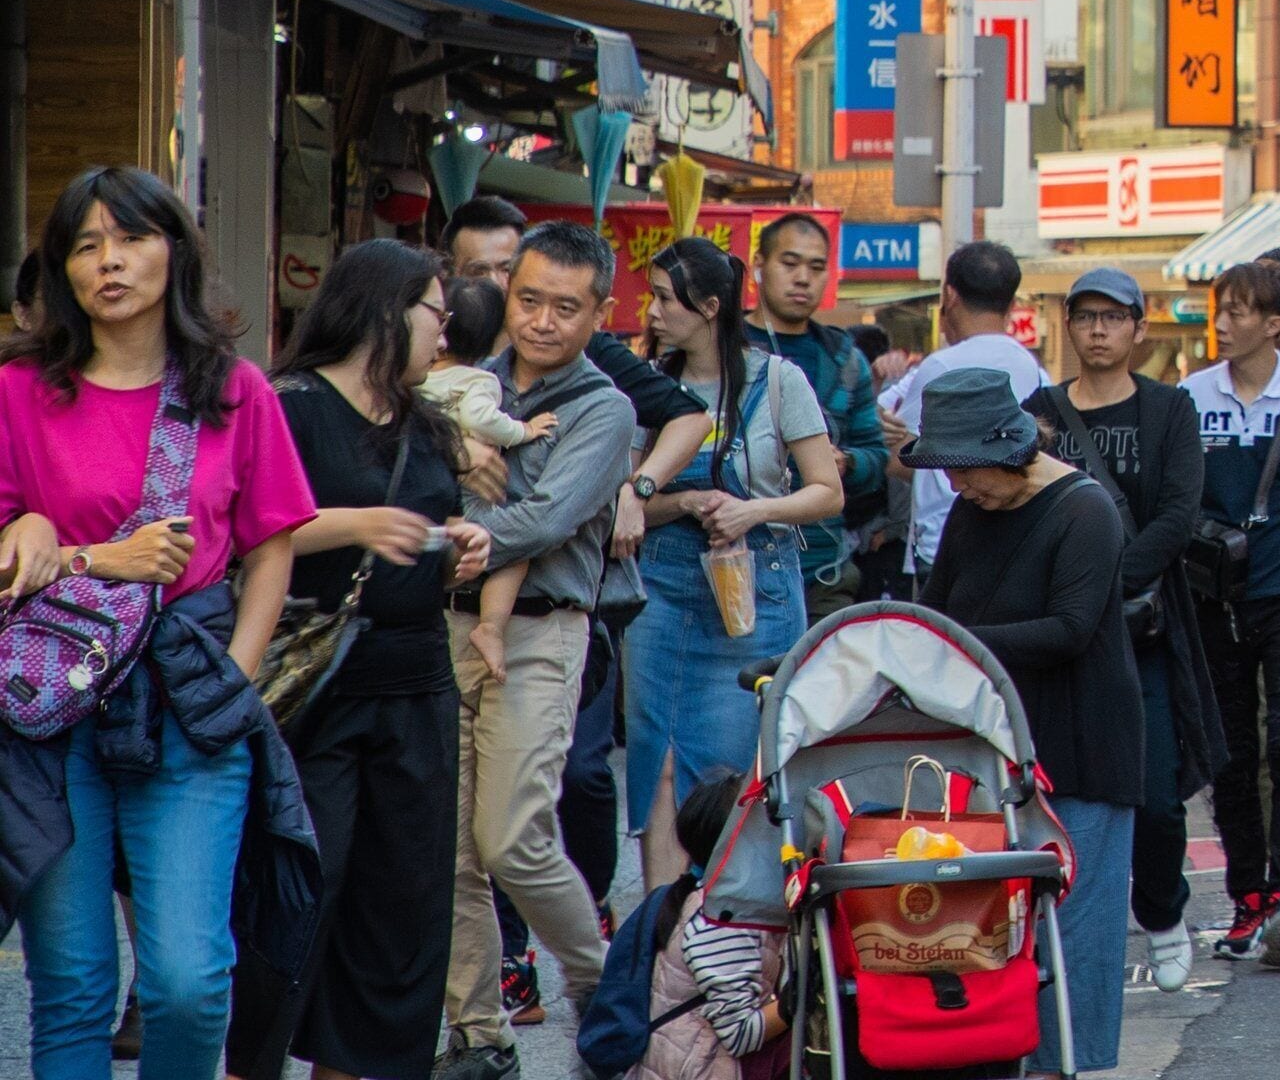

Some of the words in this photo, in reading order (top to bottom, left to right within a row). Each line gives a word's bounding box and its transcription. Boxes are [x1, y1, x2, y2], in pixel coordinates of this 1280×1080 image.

[853, 238, 912, 262] ATM
[874, 942, 901, 960] bei
[906, 941, 965, 961] Stefan
